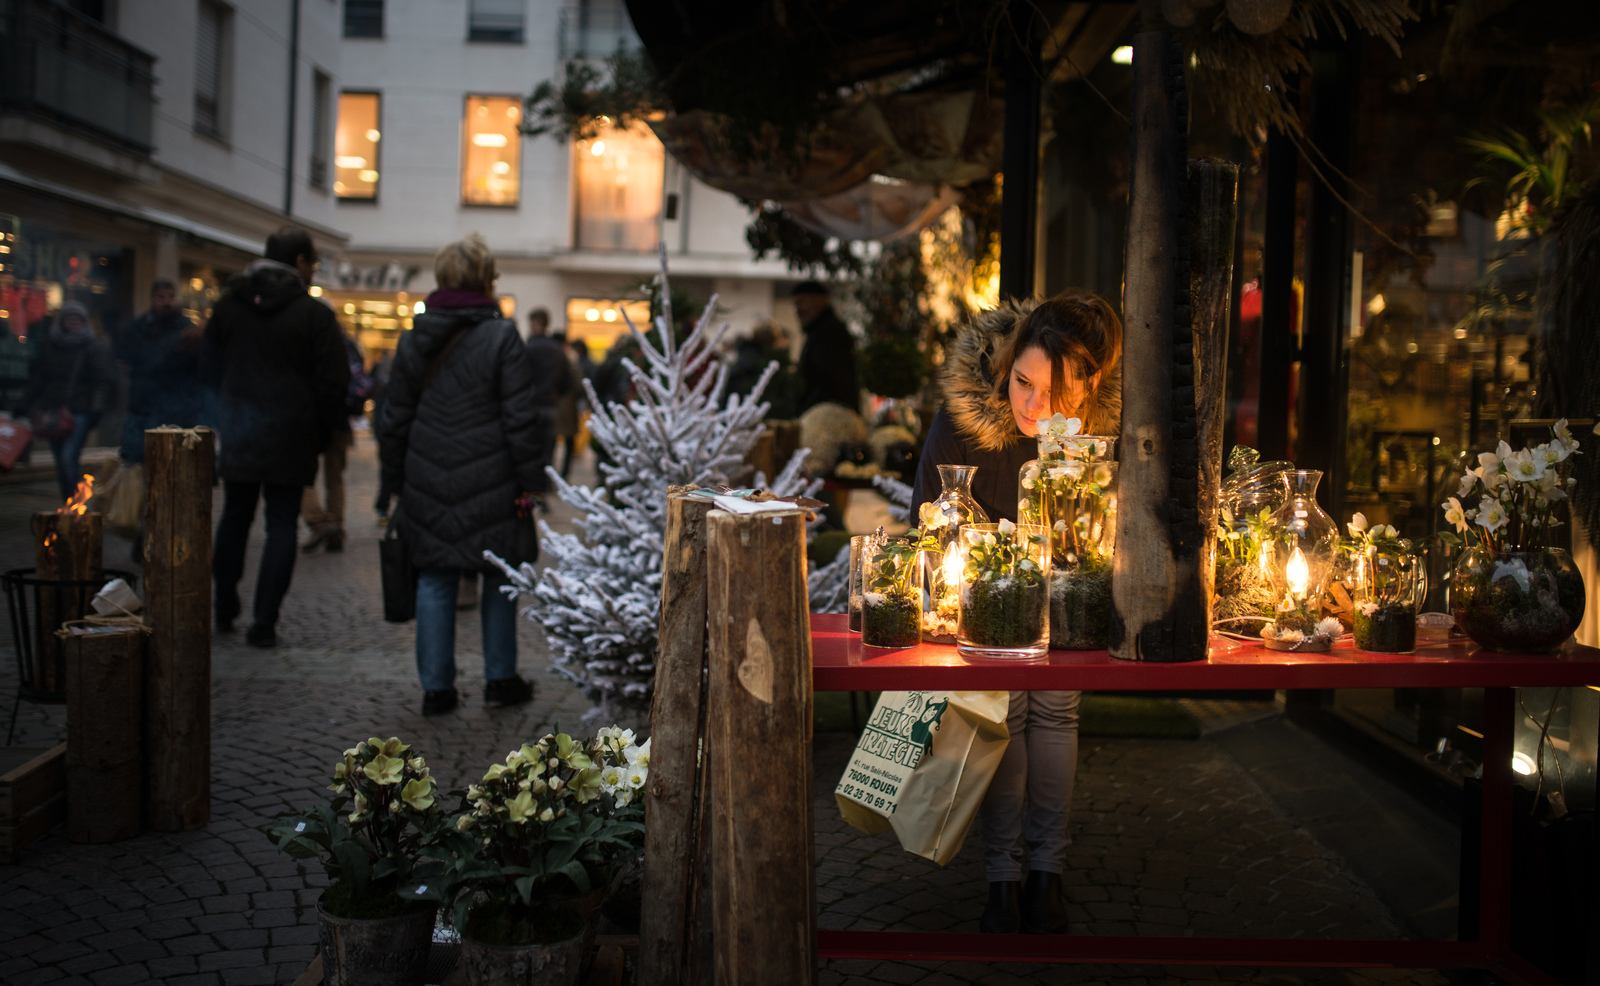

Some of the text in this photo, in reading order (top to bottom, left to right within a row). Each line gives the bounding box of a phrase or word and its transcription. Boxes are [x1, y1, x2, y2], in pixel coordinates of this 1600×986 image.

[872, 706, 909, 735] JEUX
[857, 728, 924, 769] TRATEGIE
[848, 769, 898, 797] 76000 ROUEN
[843, 784, 898, 814] 02 35 70 69 71
